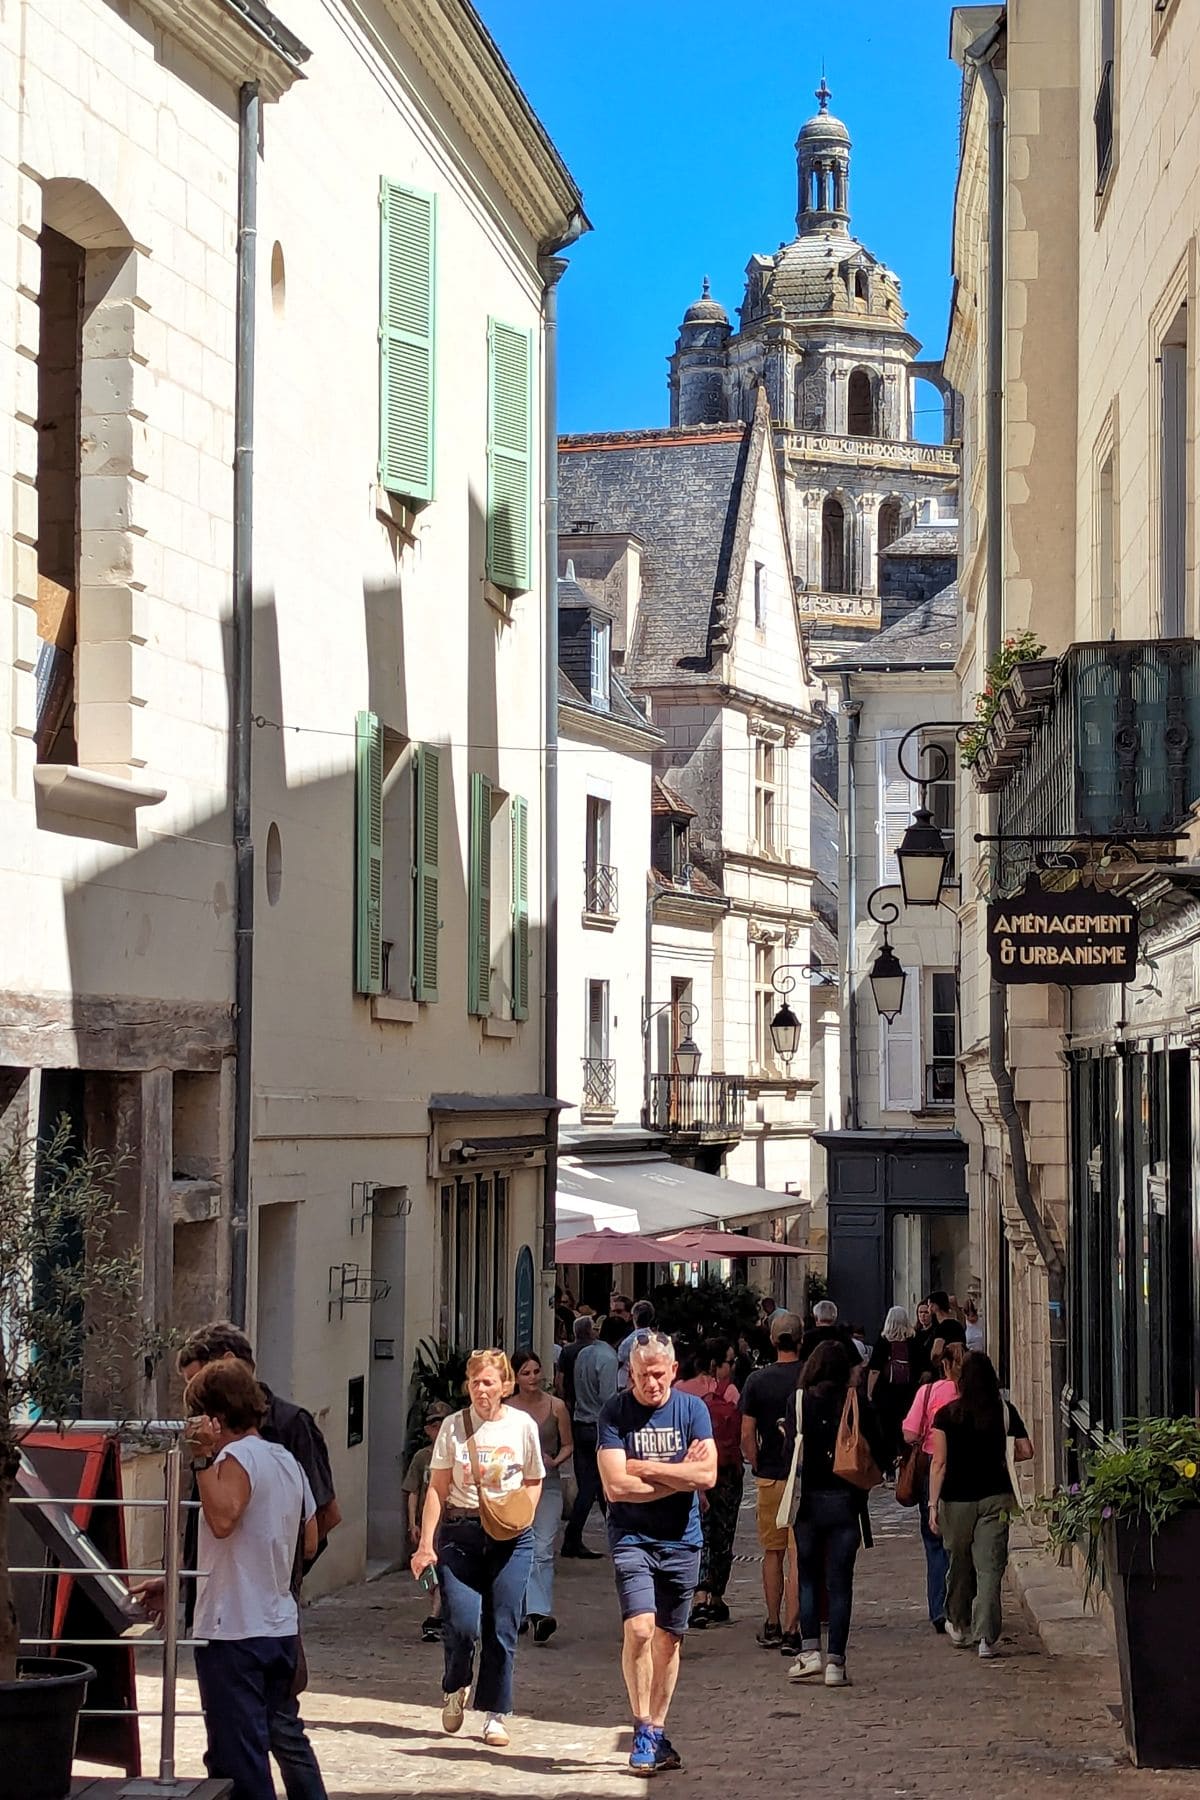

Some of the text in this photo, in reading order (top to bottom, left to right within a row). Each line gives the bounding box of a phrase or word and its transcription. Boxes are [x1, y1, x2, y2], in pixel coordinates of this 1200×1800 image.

[993, 912, 1133, 934] AMÉNAGEMENT
[1000, 937, 1016, 965] &
[633, 1430, 683, 1452] FRANCE
